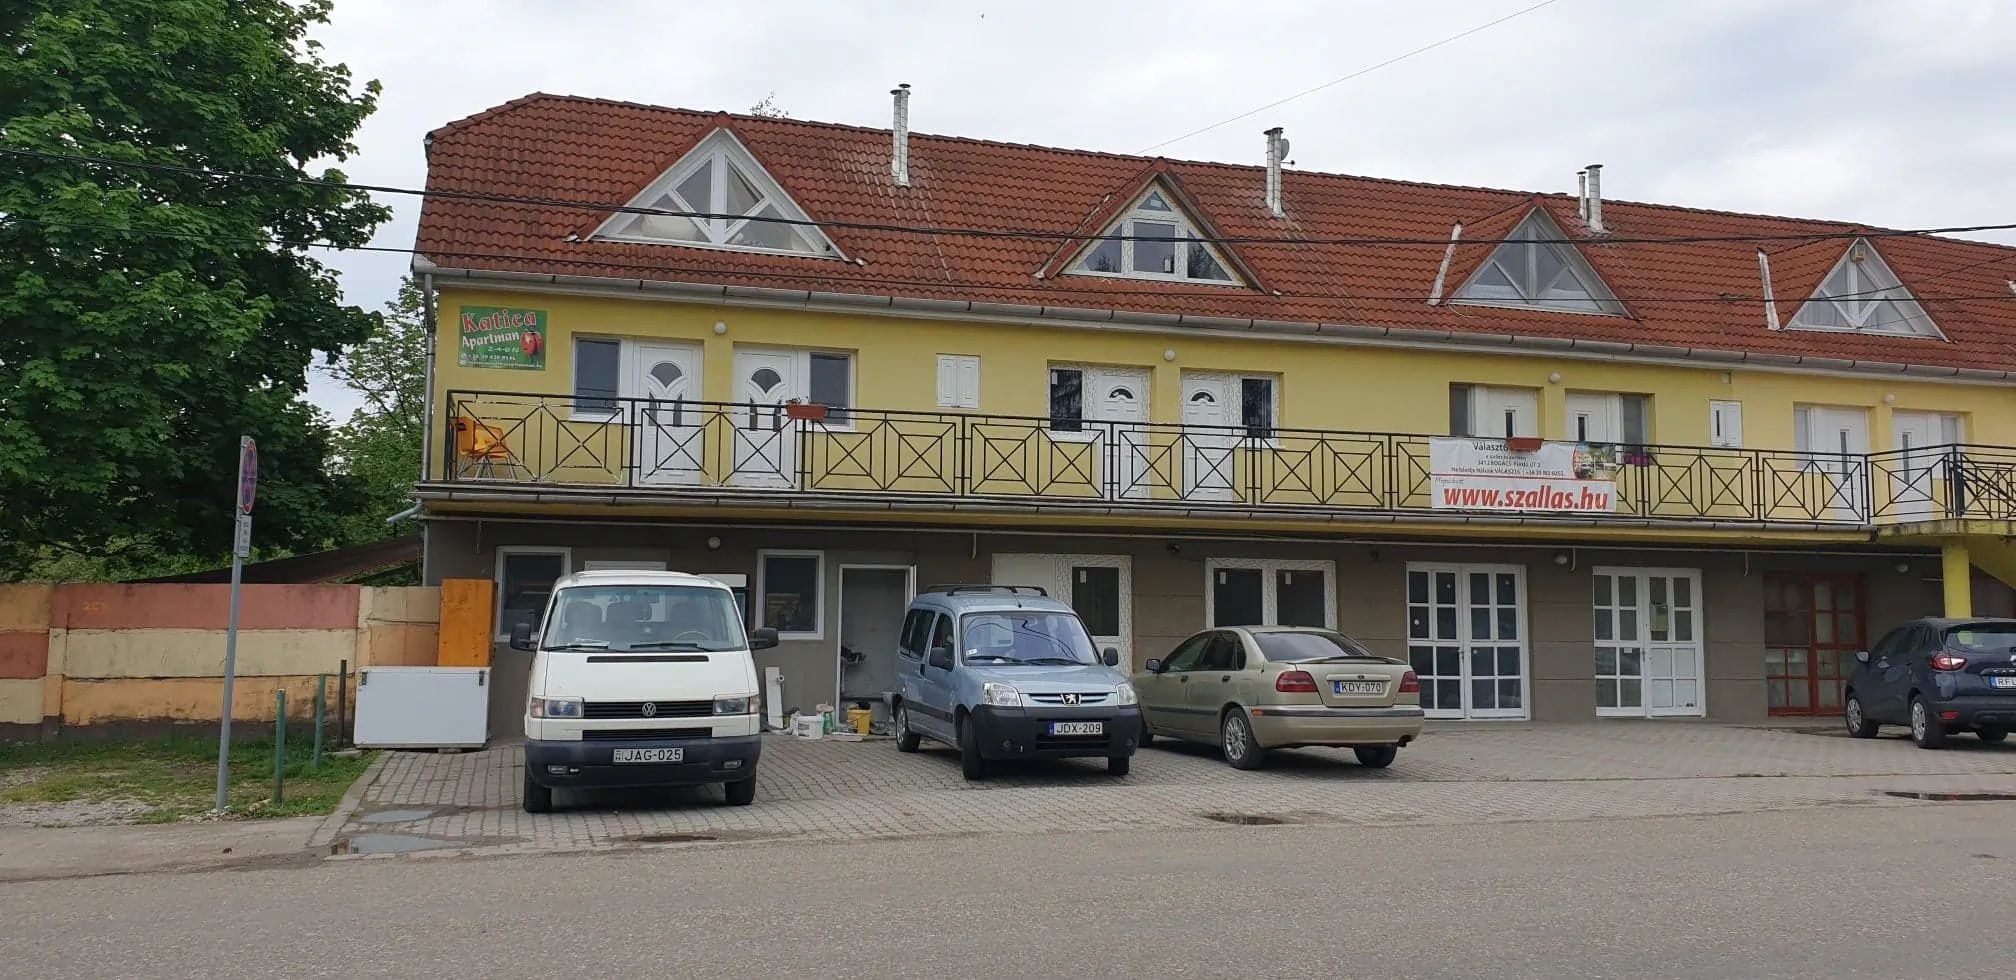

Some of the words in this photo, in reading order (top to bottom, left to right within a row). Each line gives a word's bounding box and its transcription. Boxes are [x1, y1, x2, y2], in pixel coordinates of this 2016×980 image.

[462, 308, 537, 333] Katica
[462, 332, 520, 350] Apartman
[1443, 485, 1609, 510] www.szallas.hu
[1341, 682, 1382, 693] KDY-070
[1056, 723, 1101, 734] JDX-209
[624, 749, 681, 761] JAG-025
